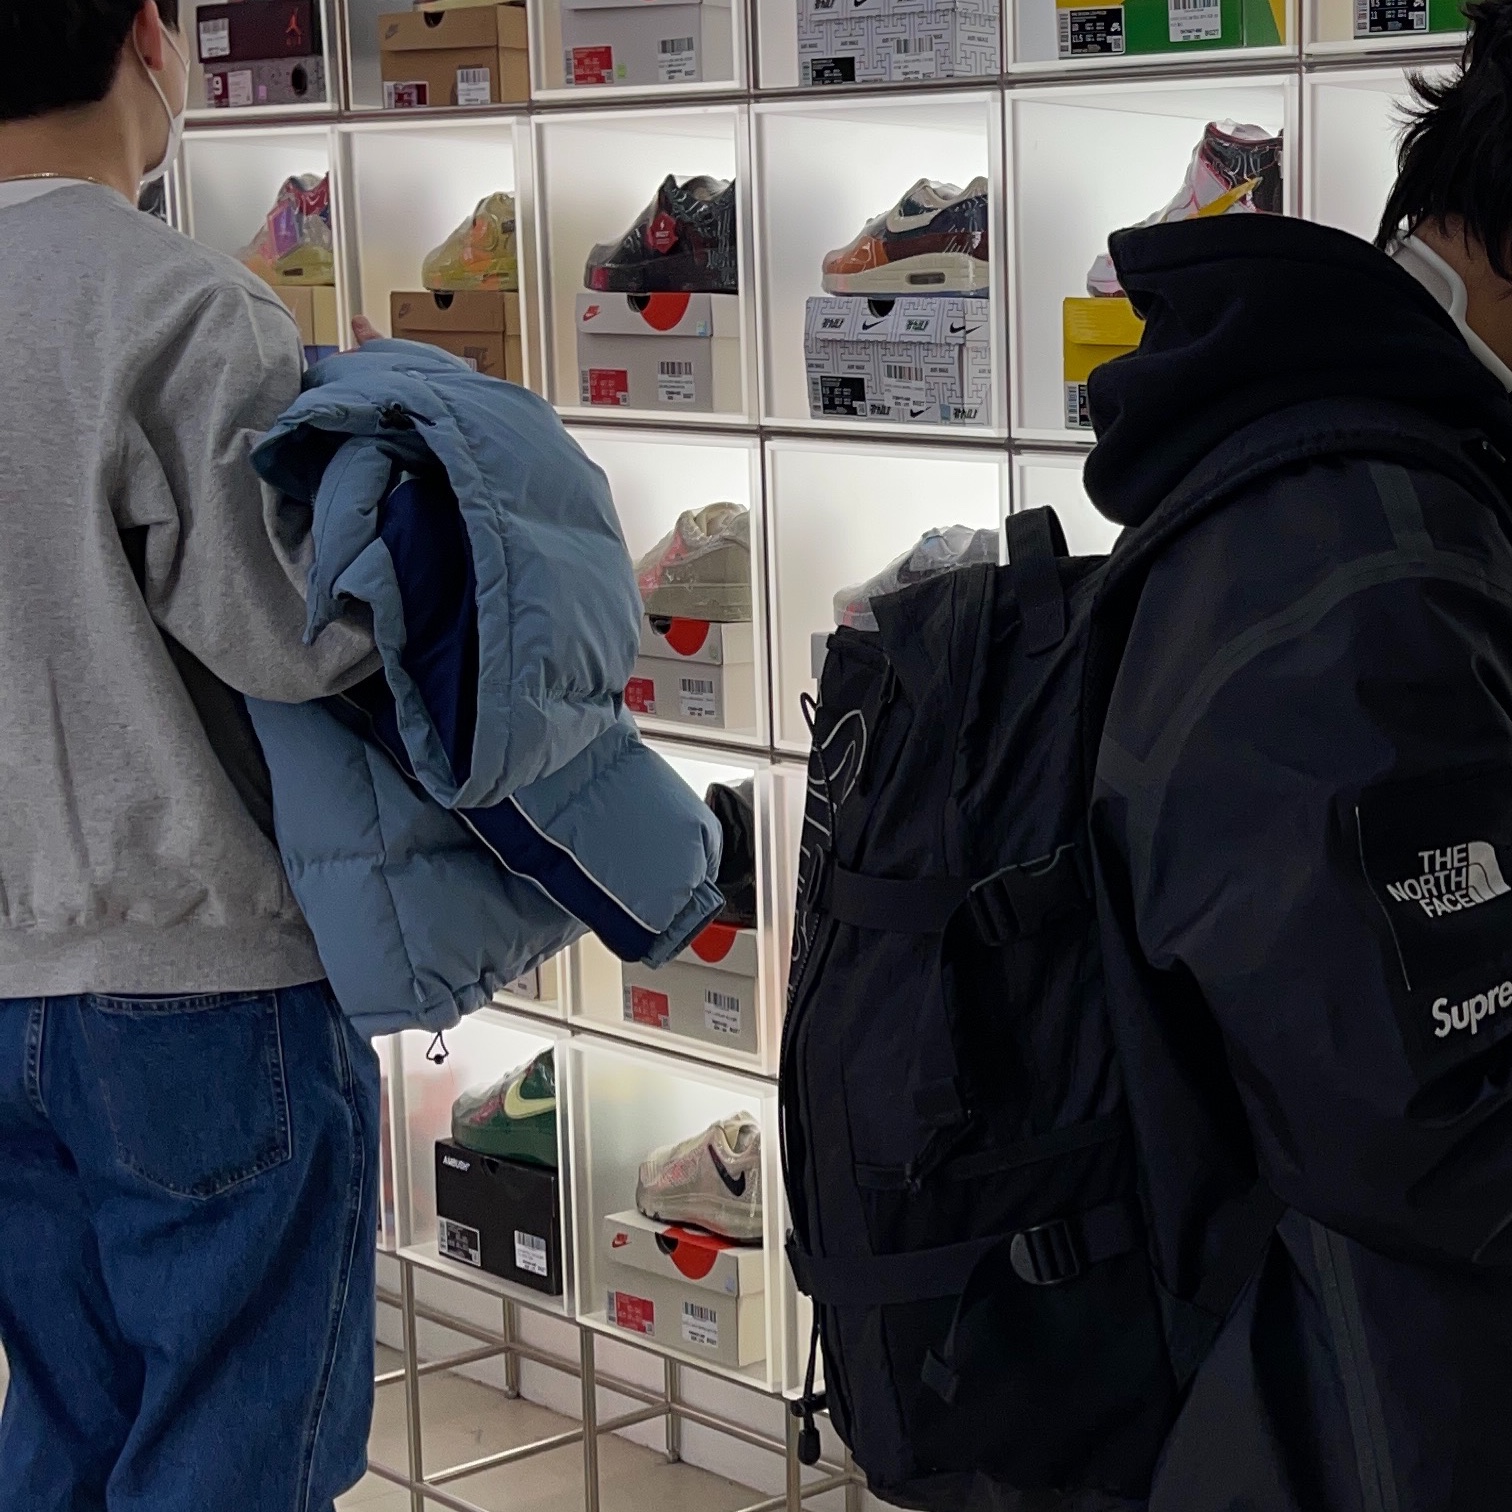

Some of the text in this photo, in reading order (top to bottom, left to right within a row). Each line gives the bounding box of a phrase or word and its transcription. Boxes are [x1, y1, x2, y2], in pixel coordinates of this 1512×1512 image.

[1418, 843, 1468, 873] THE
[1387, 867, 1468, 902] NORTH
[1419, 889, 1477, 918] FACE
